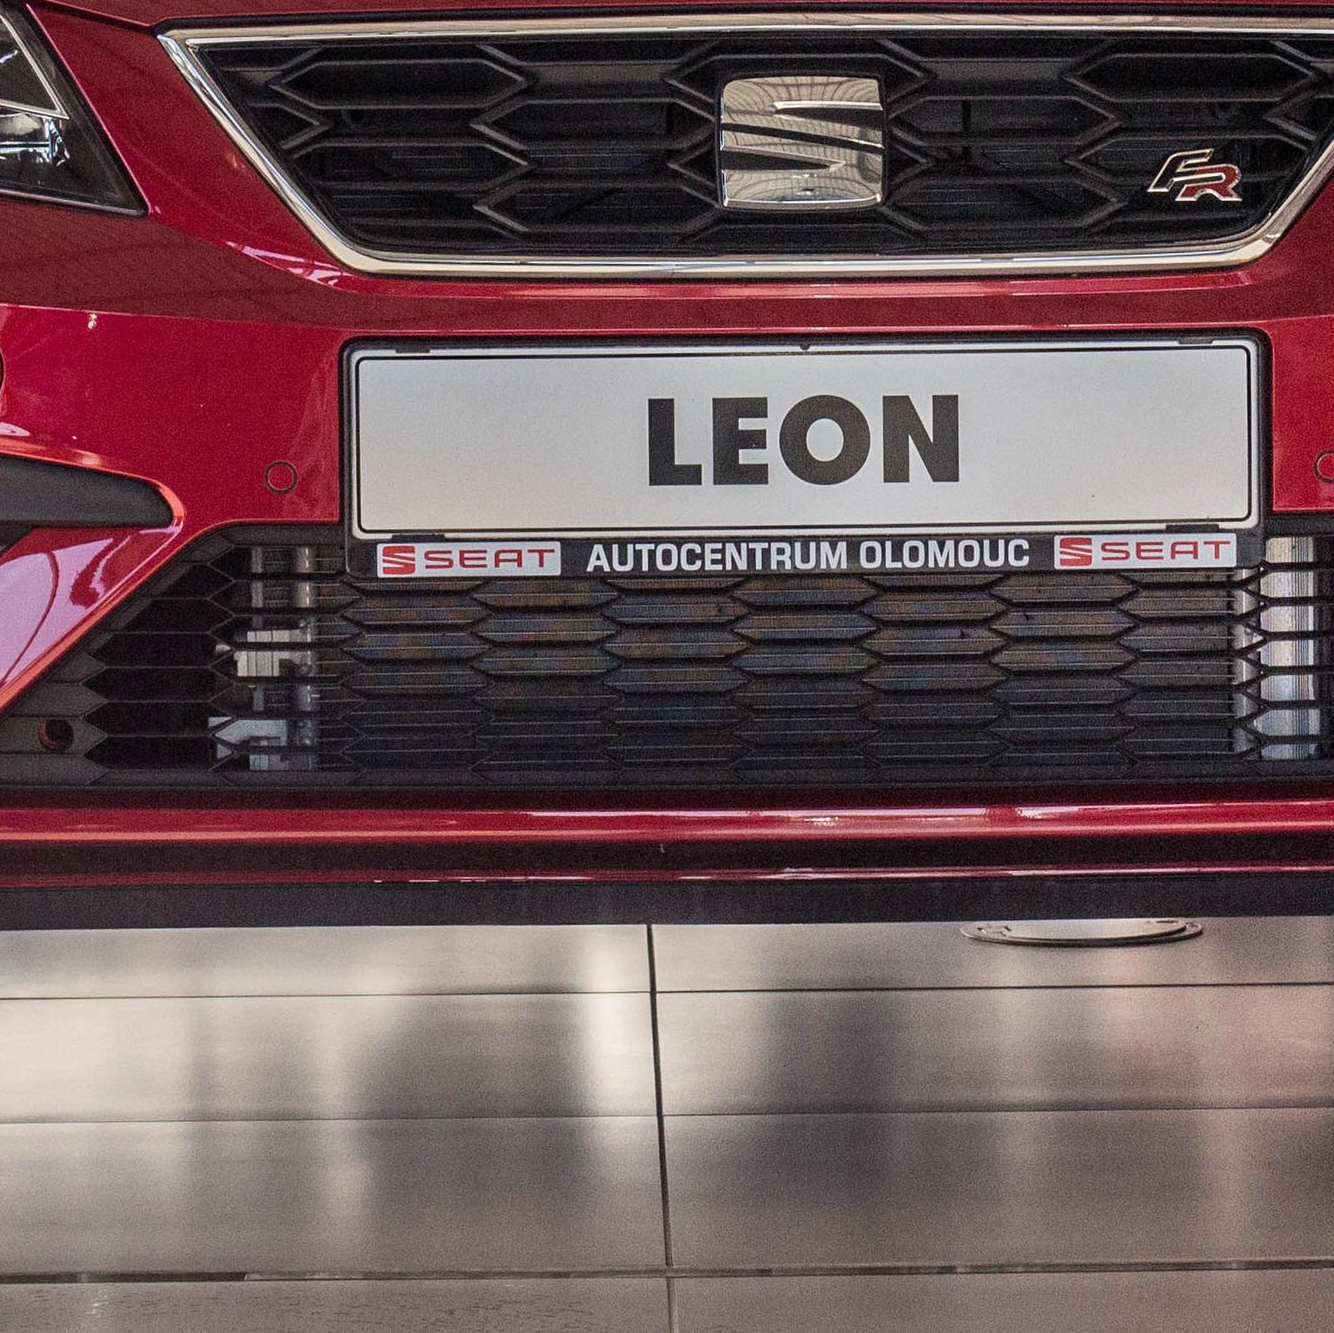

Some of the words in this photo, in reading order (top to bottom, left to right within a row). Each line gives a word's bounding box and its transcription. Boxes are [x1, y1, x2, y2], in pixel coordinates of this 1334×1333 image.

[1147, 148, 1243, 202] FR
[648, 394, 960, 486] LEON
[424, 547, 556, 570] SEAT
[586, 541, 848, 573] AUTOCENTRUM
[859, 539, 1030, 568] OLOMOUC
[1101, 539, 1231, 562] SEAT
